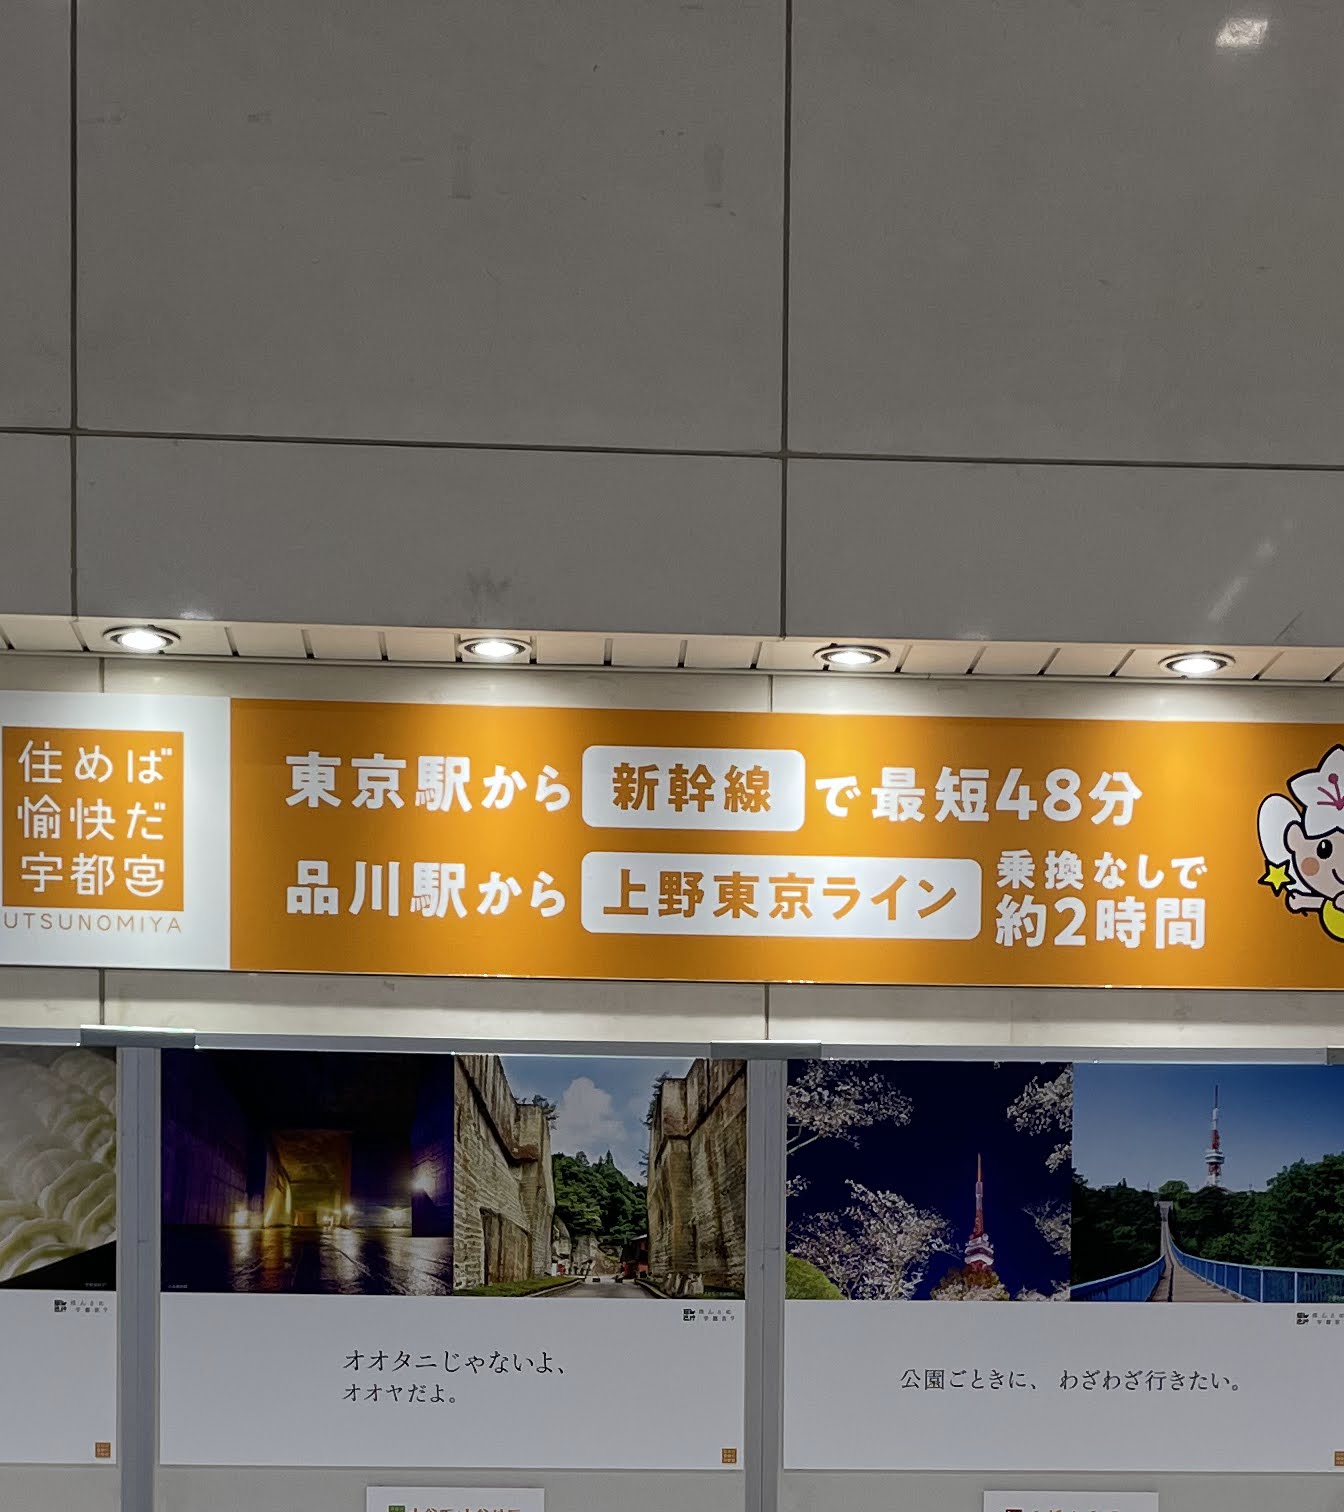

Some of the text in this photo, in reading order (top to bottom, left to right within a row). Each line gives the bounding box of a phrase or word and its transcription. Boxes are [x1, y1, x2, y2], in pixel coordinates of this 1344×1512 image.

[18, 738, 174, 785] 住めば
[286, 749, 1144, 828] 東京駅から 新幹線 で最短48分
[17, 795, 166, 842] 愉快だ
[19, 851, 166, 898] 宇都宮
[286, 859, 958, 922] 品川駅から 上野東京ライン
[996, 850, 1208, 890] 乗換なしで
[2, 910, 184, 935] UTSUNOMIYA
[995, 896, 1207, 951] 約2時間
[342, 1350, 567, 1375] オオタニじゃないよ、
[900, 1368, 1242, 1394] 公園ごときに、 わざわざ行きたい。
[342, 1383, 458, 1405] オオヤだよ。
